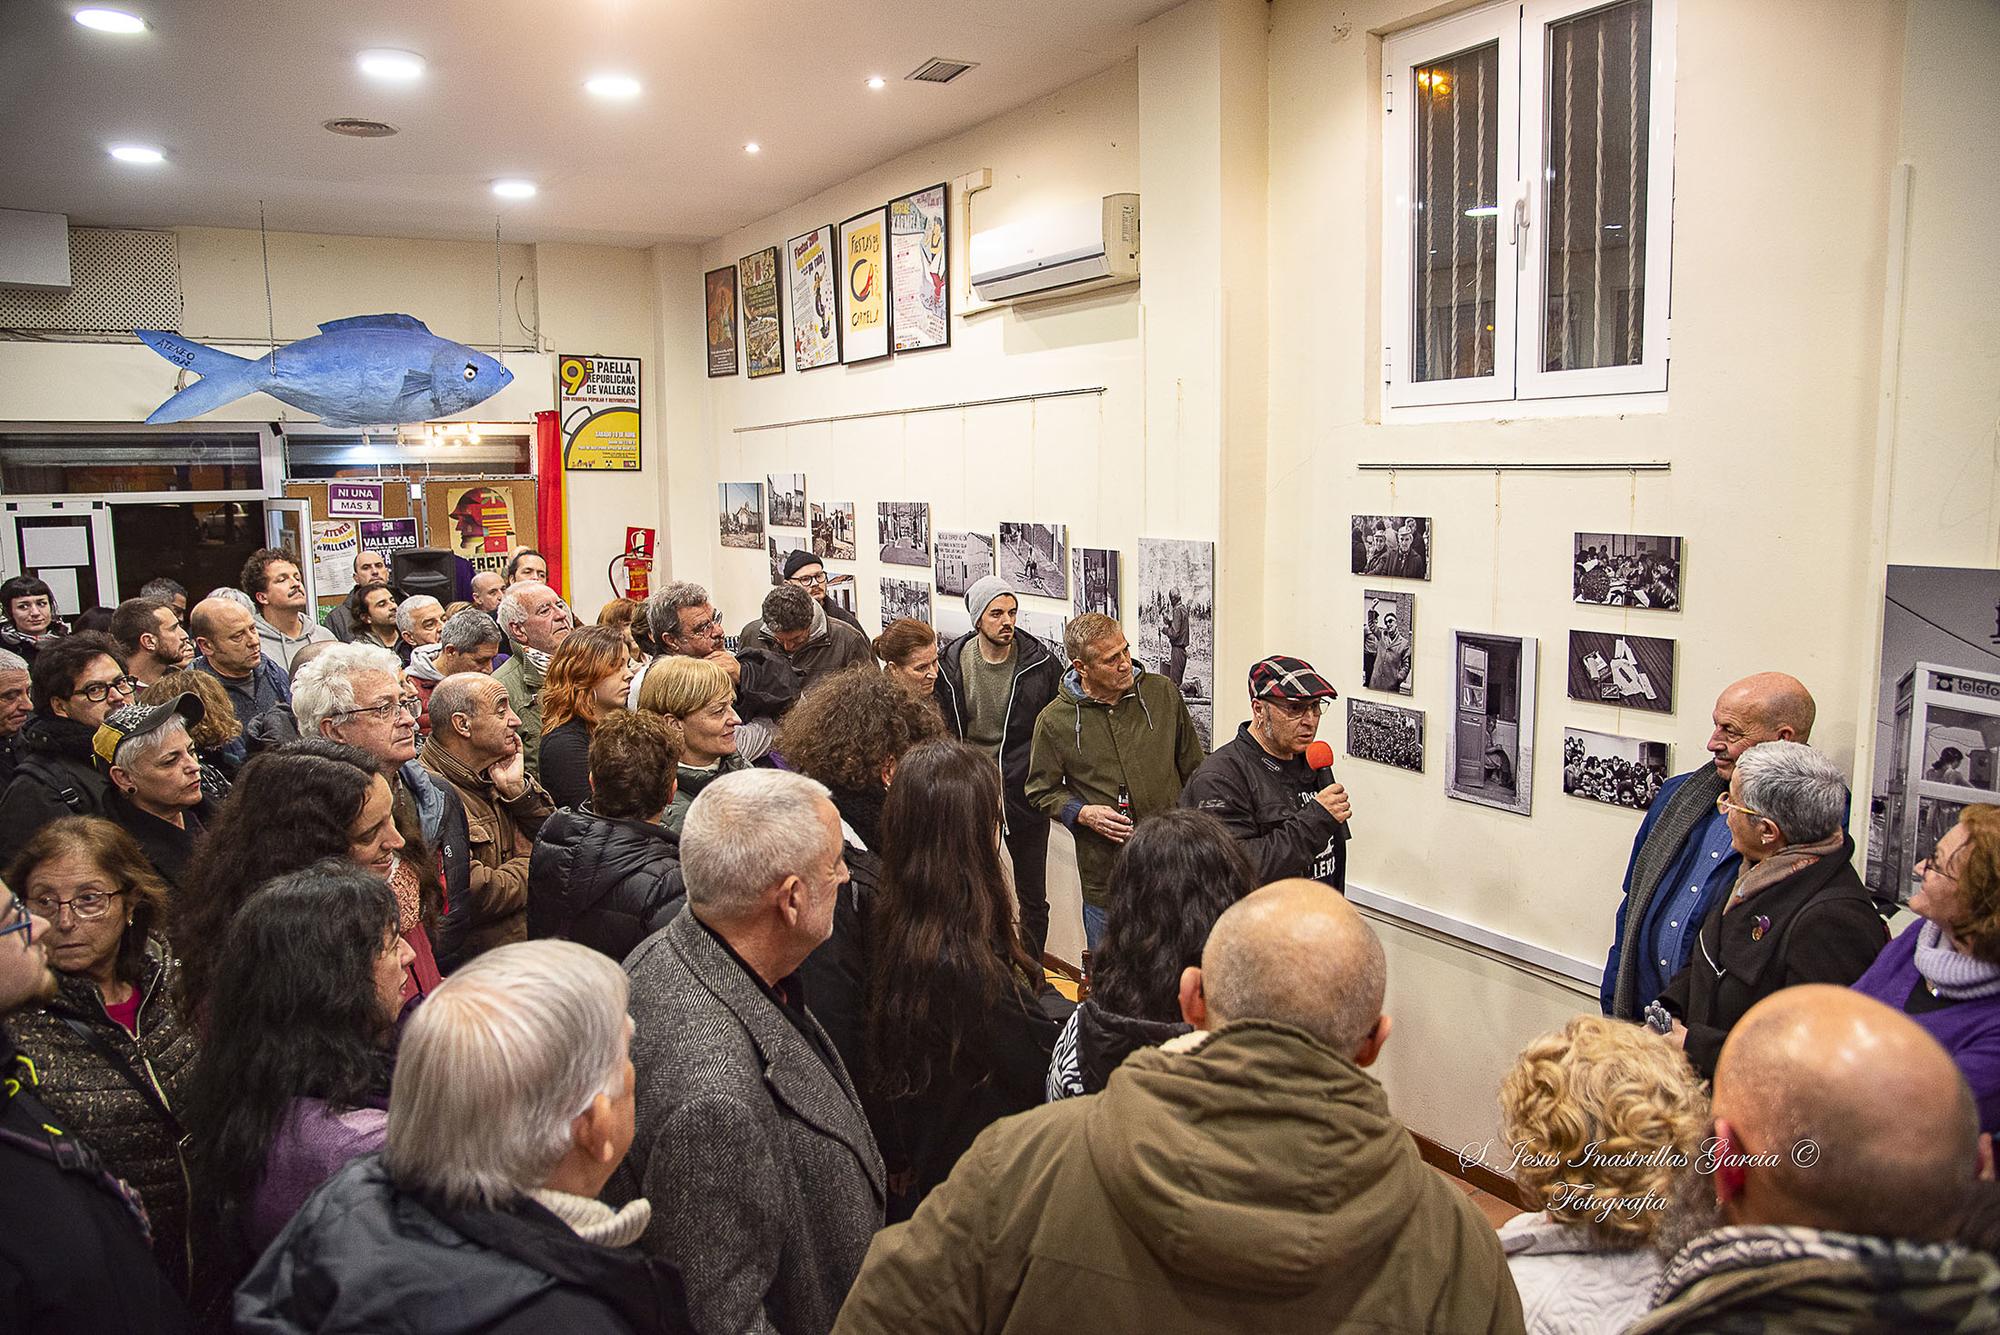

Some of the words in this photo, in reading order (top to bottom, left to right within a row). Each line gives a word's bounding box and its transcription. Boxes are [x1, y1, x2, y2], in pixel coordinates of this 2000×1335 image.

[155, 339, 195, 360] ATENEO
[597, 361, 632, 374] PAELLA
[588, 374, 636, 385] REPUBLICANA
[586, 385, 597, 394] DE
[599, 385, 636, 395] VALLEKAS
[338, 488, 349, 497] NI
[351, 489, 373, 498] UNA
[323, 522, 352, 538] ATENEO
[322, 538, 357, 551] VALLEKAS
[363, 536, 416, 547] VALLEKAS
[1958, 679, 2000, 697] telefo
